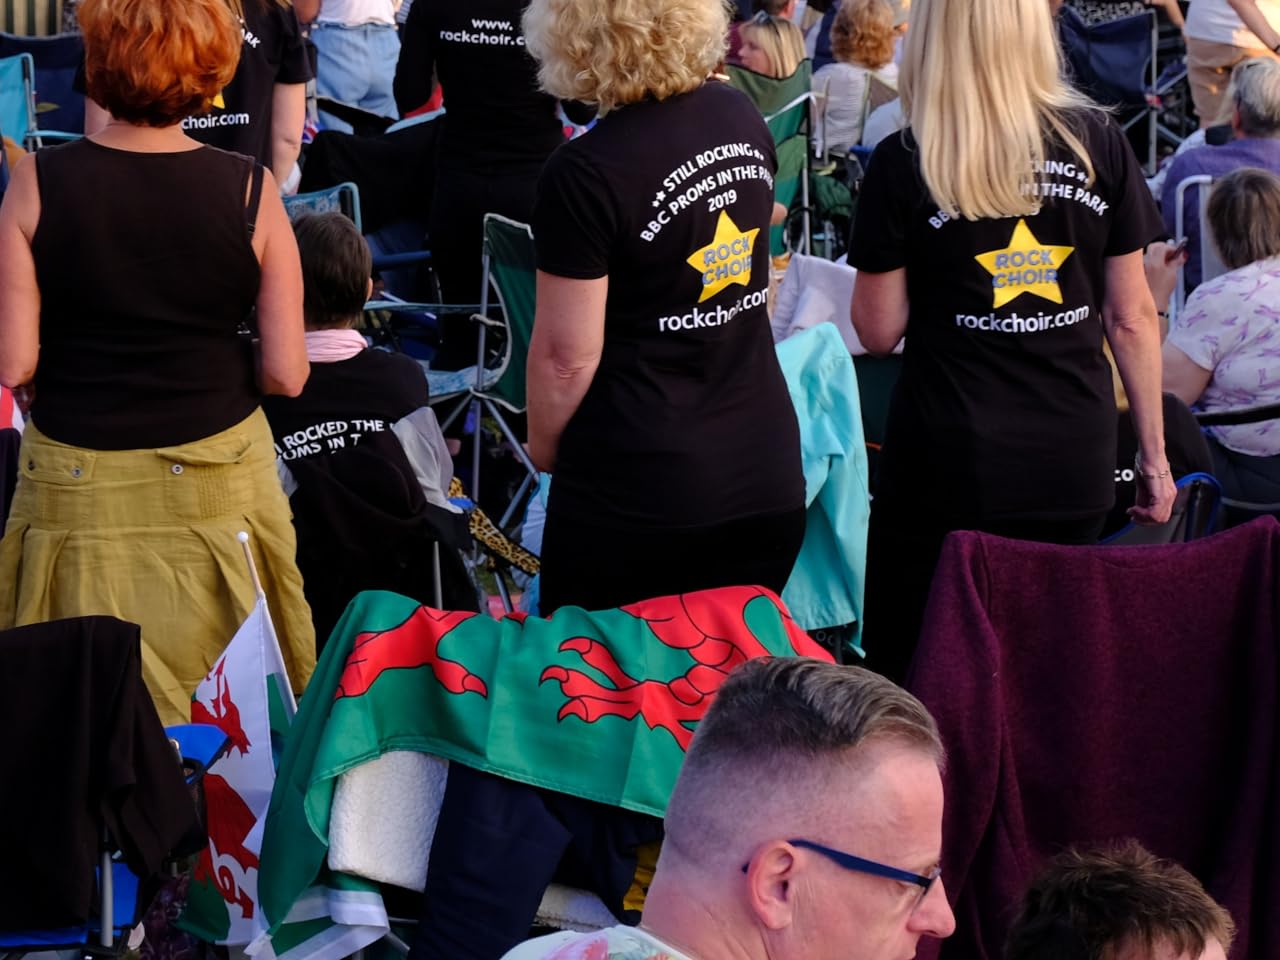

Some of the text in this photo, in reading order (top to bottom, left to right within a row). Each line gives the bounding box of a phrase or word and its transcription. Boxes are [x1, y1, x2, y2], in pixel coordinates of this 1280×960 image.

[471, 19, 513, 31] www.
[440, 30, 526, 46] rockchoir.c
[181, 113, 250, 130] choir.com
[662, 142, 754, 193] STILL ROCKING
[639, 209, 671, 242] BBC
[668, 175, 717, 216] PROMS
[716, 169, 734, 187] IN
[734, 165, 758, 181] THE
[707, 189, 738, 213] 2019
[1040, 182, 1074, 199] THE
[1074, 188, 1110, 216] PARK
[703, 235, 750, 268] ROCK
[994, 249, 1054, 271] ROCK
[991, 269, 1058, 289] CHOIR
[955, 305, 1090, 334] rockchoir.com
[282, 420, 348, 450] ROCKED
[350, 419, 385, 432] THE
[277, 442, 322, 461] OMS
[327, 436, 345, 450] IN
